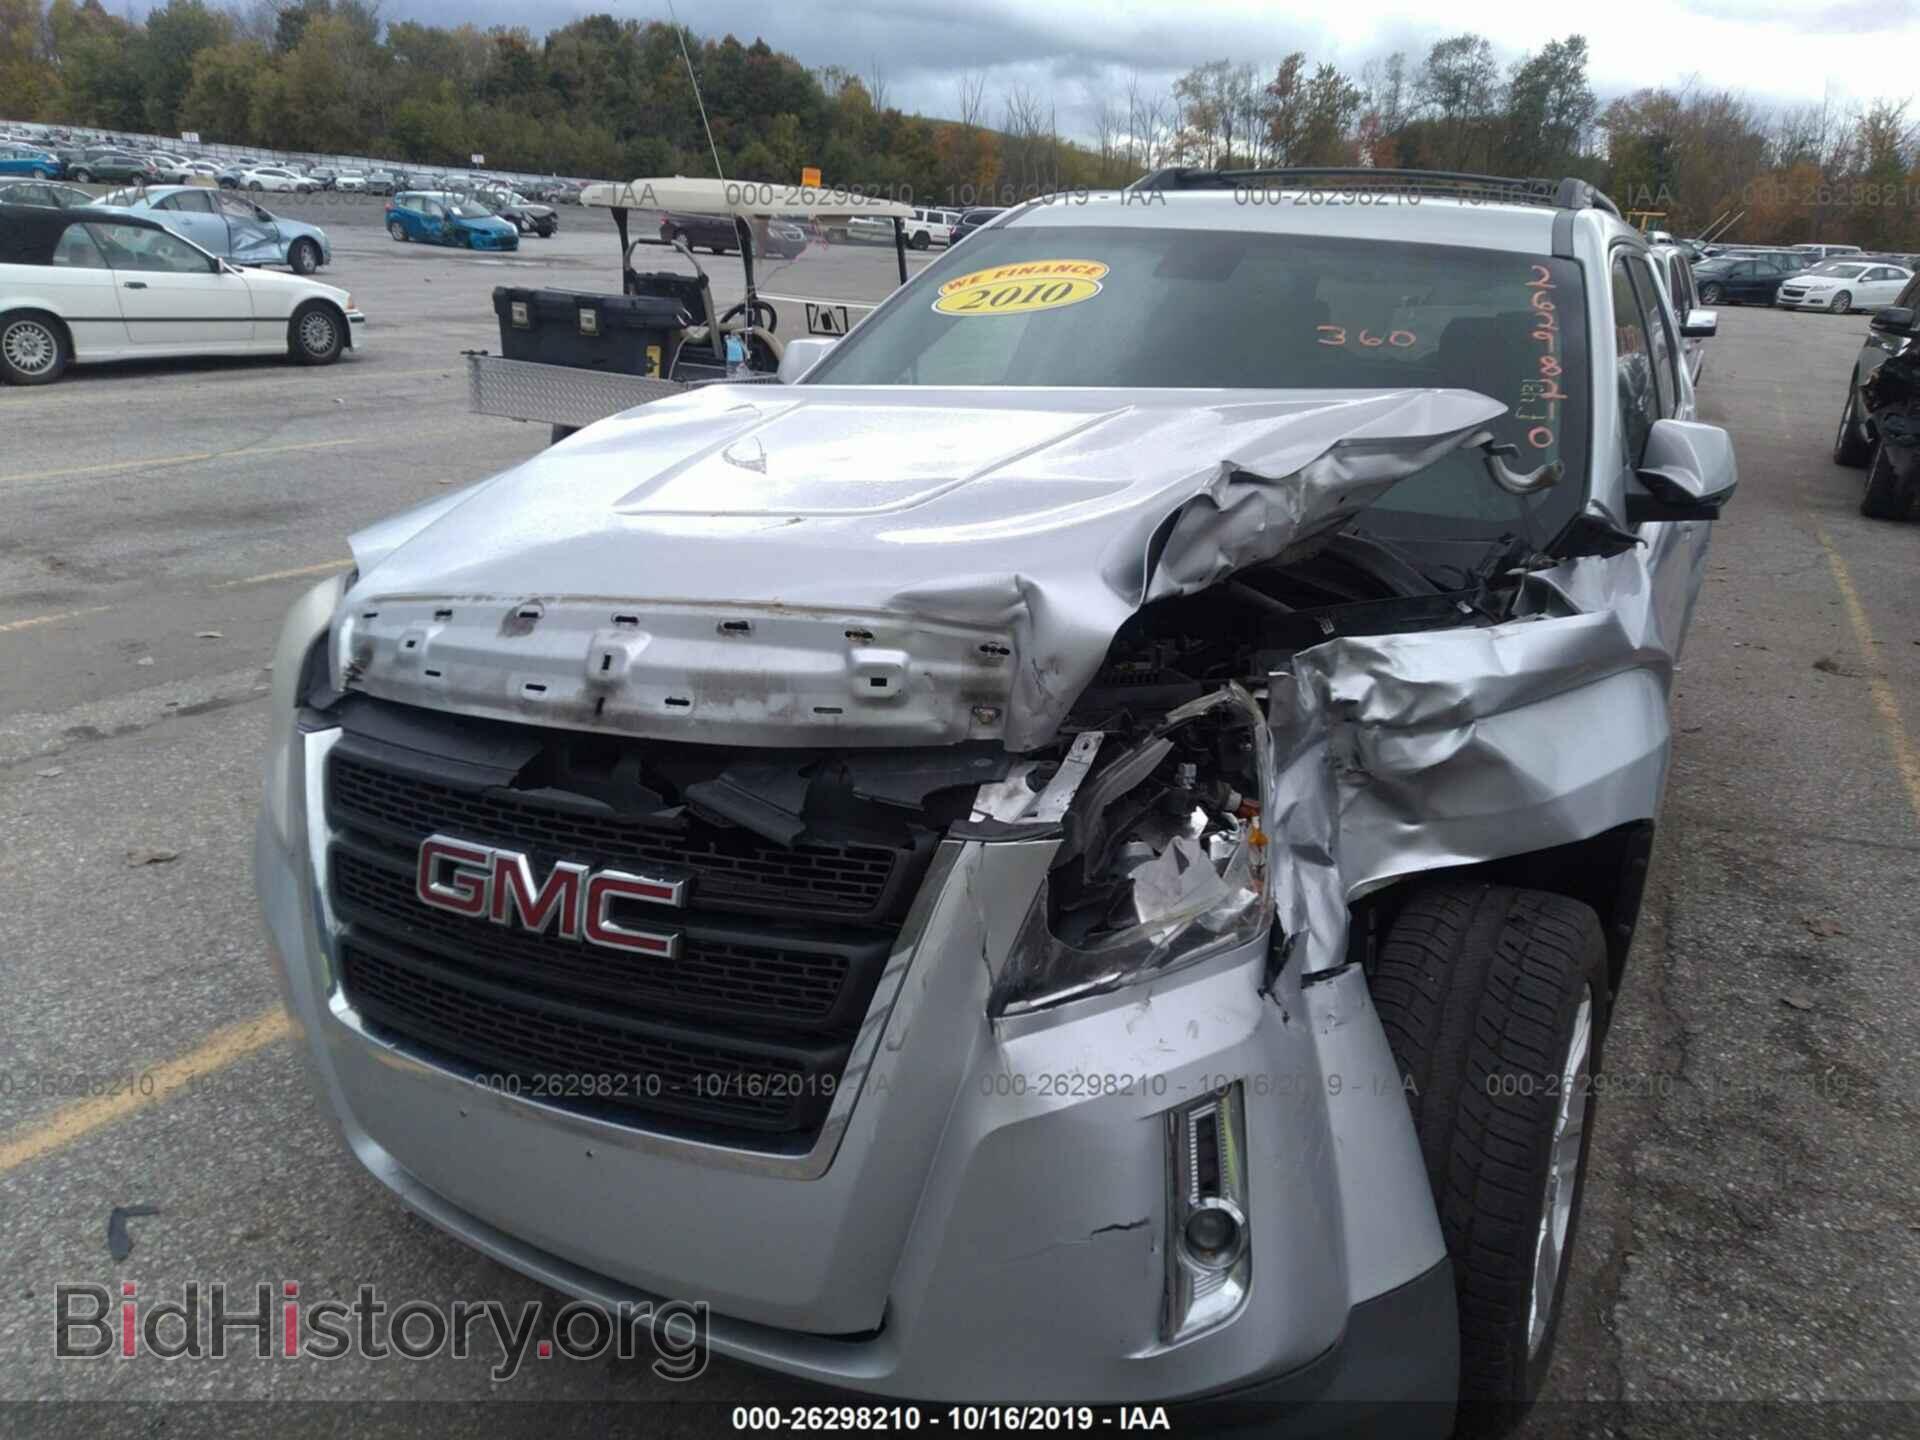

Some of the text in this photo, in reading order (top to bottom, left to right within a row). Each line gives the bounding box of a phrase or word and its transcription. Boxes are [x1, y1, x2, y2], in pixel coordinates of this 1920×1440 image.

[948, 263, 1102, 290] WE FINANCE
[957, 281, 1075, 310] 2010
[417, 833, 686, 960] GMC
